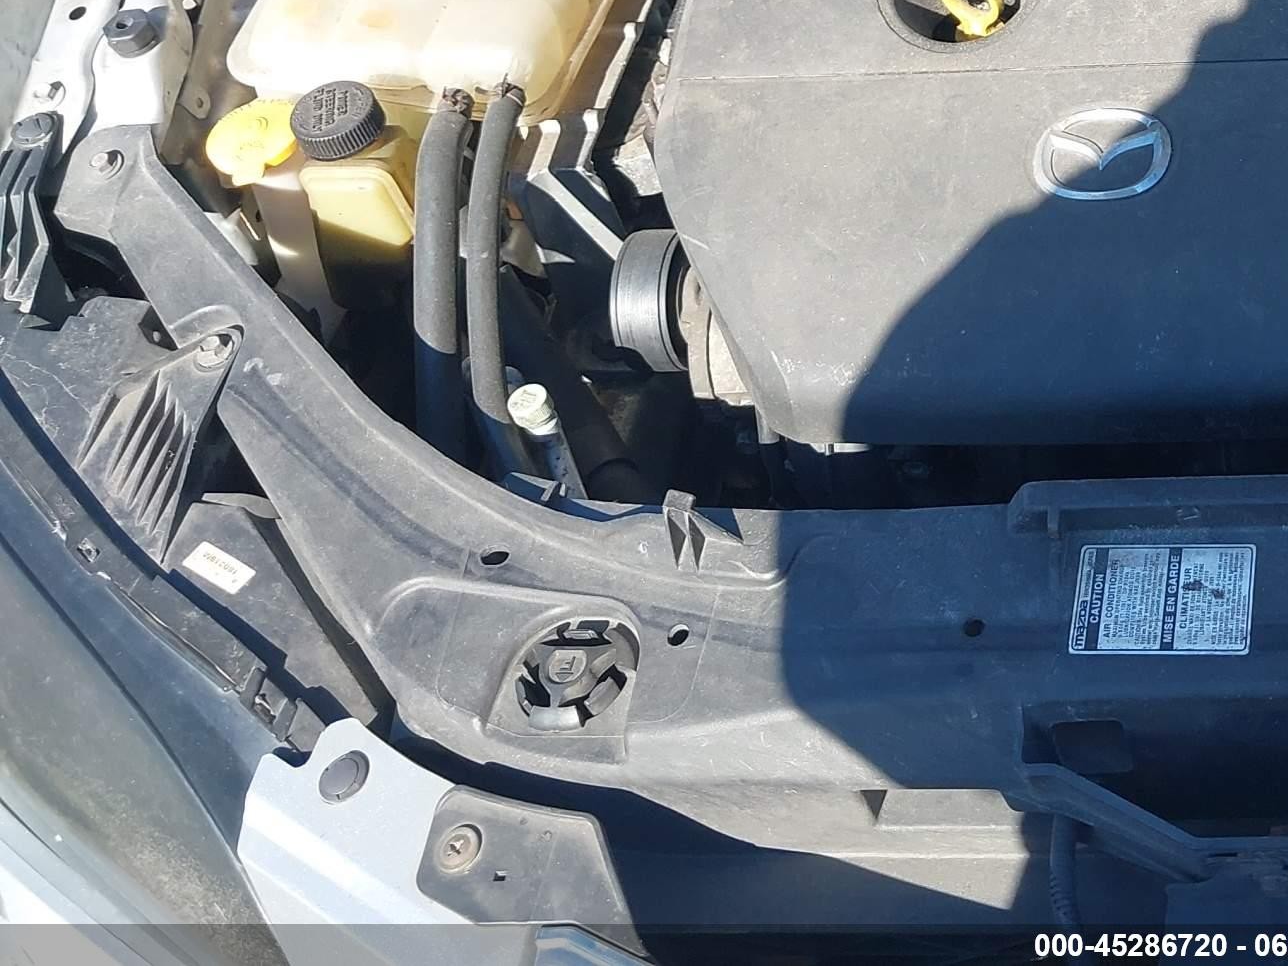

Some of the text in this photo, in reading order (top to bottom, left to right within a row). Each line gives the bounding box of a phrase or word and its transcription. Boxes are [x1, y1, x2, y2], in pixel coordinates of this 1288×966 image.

[1074, 601, 1088, 647] mazda
[1089, 574, 1104, 623] CAUTION
[1102, 560, 1119, 638] AIR CONDITIONER
[1162, 556, 1179, 643] MISE EN GARDE
